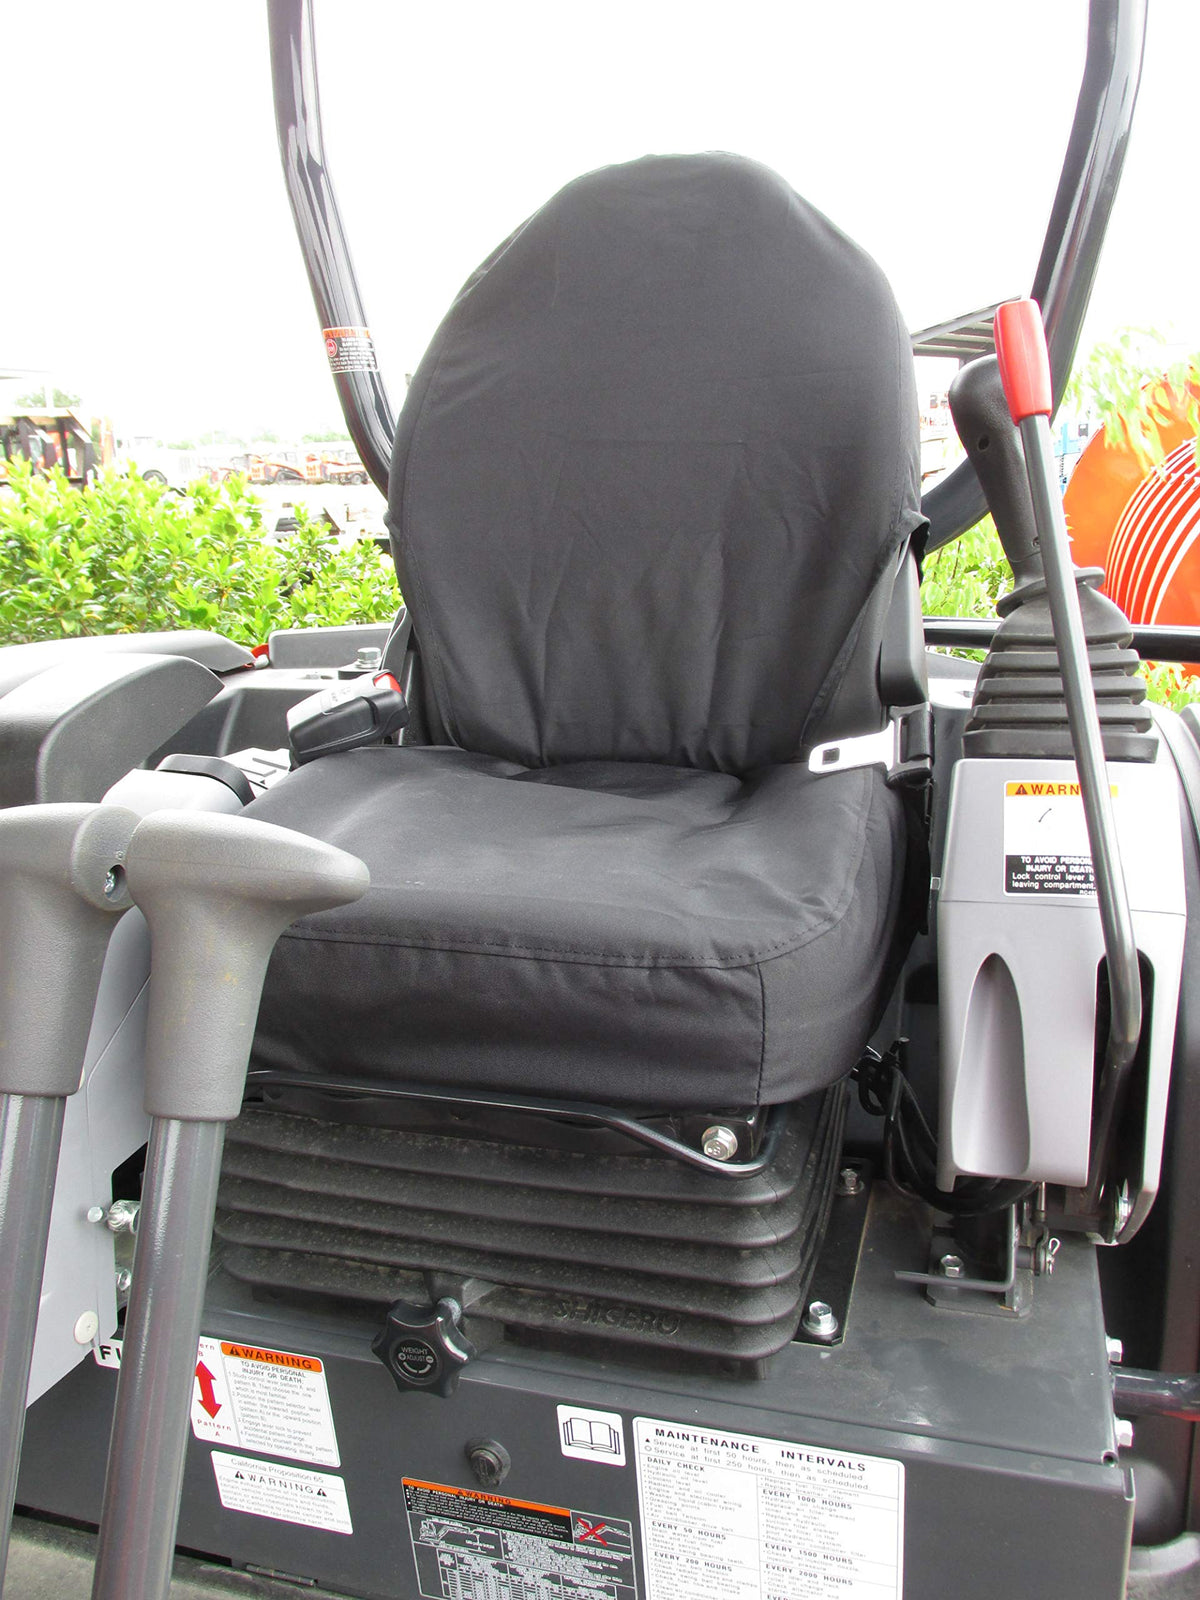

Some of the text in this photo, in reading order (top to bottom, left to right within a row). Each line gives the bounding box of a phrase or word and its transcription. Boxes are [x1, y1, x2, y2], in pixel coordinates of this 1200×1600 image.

[1030, 784, 1080, 795] WARN
[1035, 856, 1057, 864] AVOID
[1061, 857, 1093, 865] PERSON
[1012, 872, 1030, 880] Lock
[1035, 873, 1061, 881] control
[1044, 882, 1097, 890] compartment.
[242, 1348, 313, 1369] WARNING
[401, 1346, 428, 1356] WEIGHT
[406, 1354, 425, 1362] ADJUST
[197, 1418, 232, 1431] Pattern
[654, 1439, 684, 1450] Service
[691, 1445, 698, 1453] at
[704, 1448, 720, 1456] first
[726, 1451, 737, 1459] 50
[775, 1459, 794, 1469] then
[655, 1429, 865, 1472] MAINTENANCE INTERVALS
[231, 1458, 324, 1484] California Proposition 65
[647, 1457, 705, 1472] DAILY CHECK
[654, 1447, 685, 1459] Service
[691, 1453, 698, 1461] at
[704, 1455, 720, 1465] first
[726, 1459, 742, 1468] 250
[781, 1468, 800, 1478] then
[807, 1472, 816, 1481] as
[248, 1474, 313, 1494] WARNING
[763, 1489, 852, 1510] EVERY 1000 HOURS
[652, 1521, 678, 1531] EVERY
[698, 1530, 726, 1540] HOURS
[654, 1552, 680, 1562] EVERY
[705, 1561, 732, 1572] HOURS
[765, 1543, 792, 1553] EVERY
[799, 1550, 817, 1558] 1500
[823, 1554, 853, 1565] HOURS
[766, 1564, 853, 1586] EVERY 2000 HOURS
